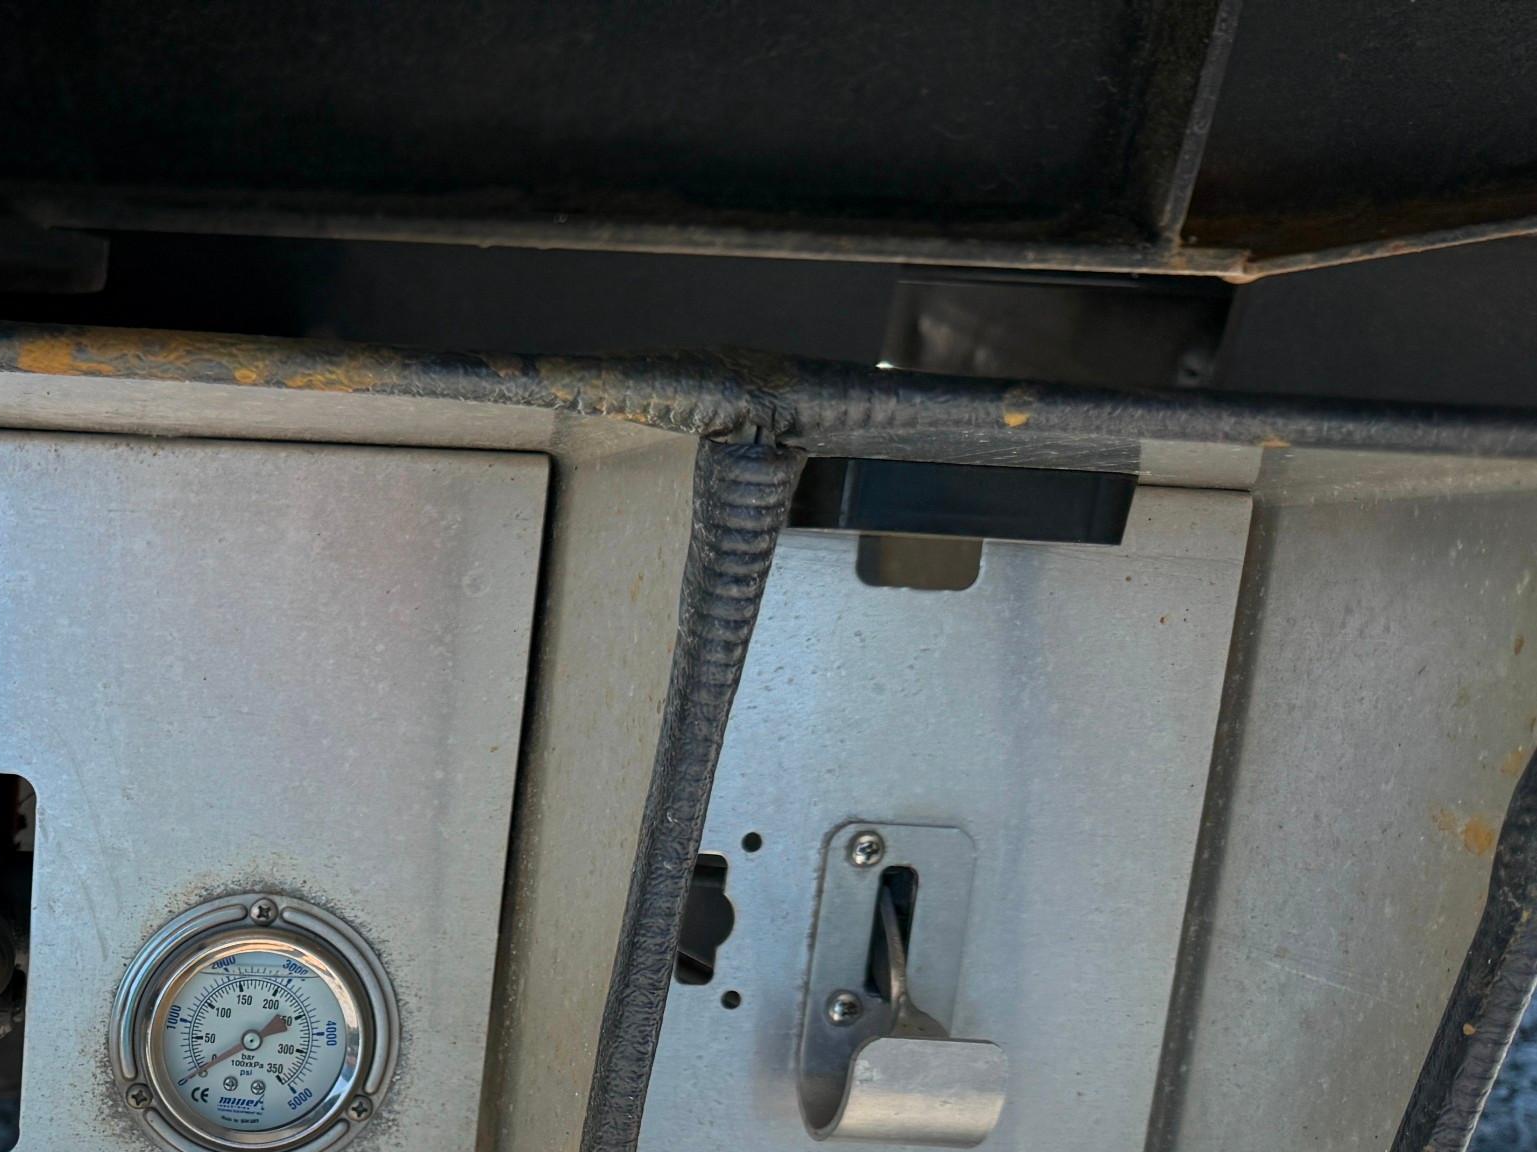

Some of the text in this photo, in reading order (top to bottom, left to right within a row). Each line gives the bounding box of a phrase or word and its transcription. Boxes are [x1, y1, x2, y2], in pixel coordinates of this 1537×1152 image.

[237, 994, 253, 1006] 150
[263, 998, 279, 1011] 200
[166, 1004, 182, 1030] 1000
[216, 1007, 232, 1019] 100
[205, 1033, 216, 1044] 50
[325, 1020, 338, 1047] 4000
[277, 1043, 295, 1056] 300
[241, 1052, 255, 1061] bar
[239, 1068, 253, 1077] psi
[267, 1062, 284, 1075] 350
[191, 1086, 210, 1103] CE
[287, 1087, 314, 1111] 5000
